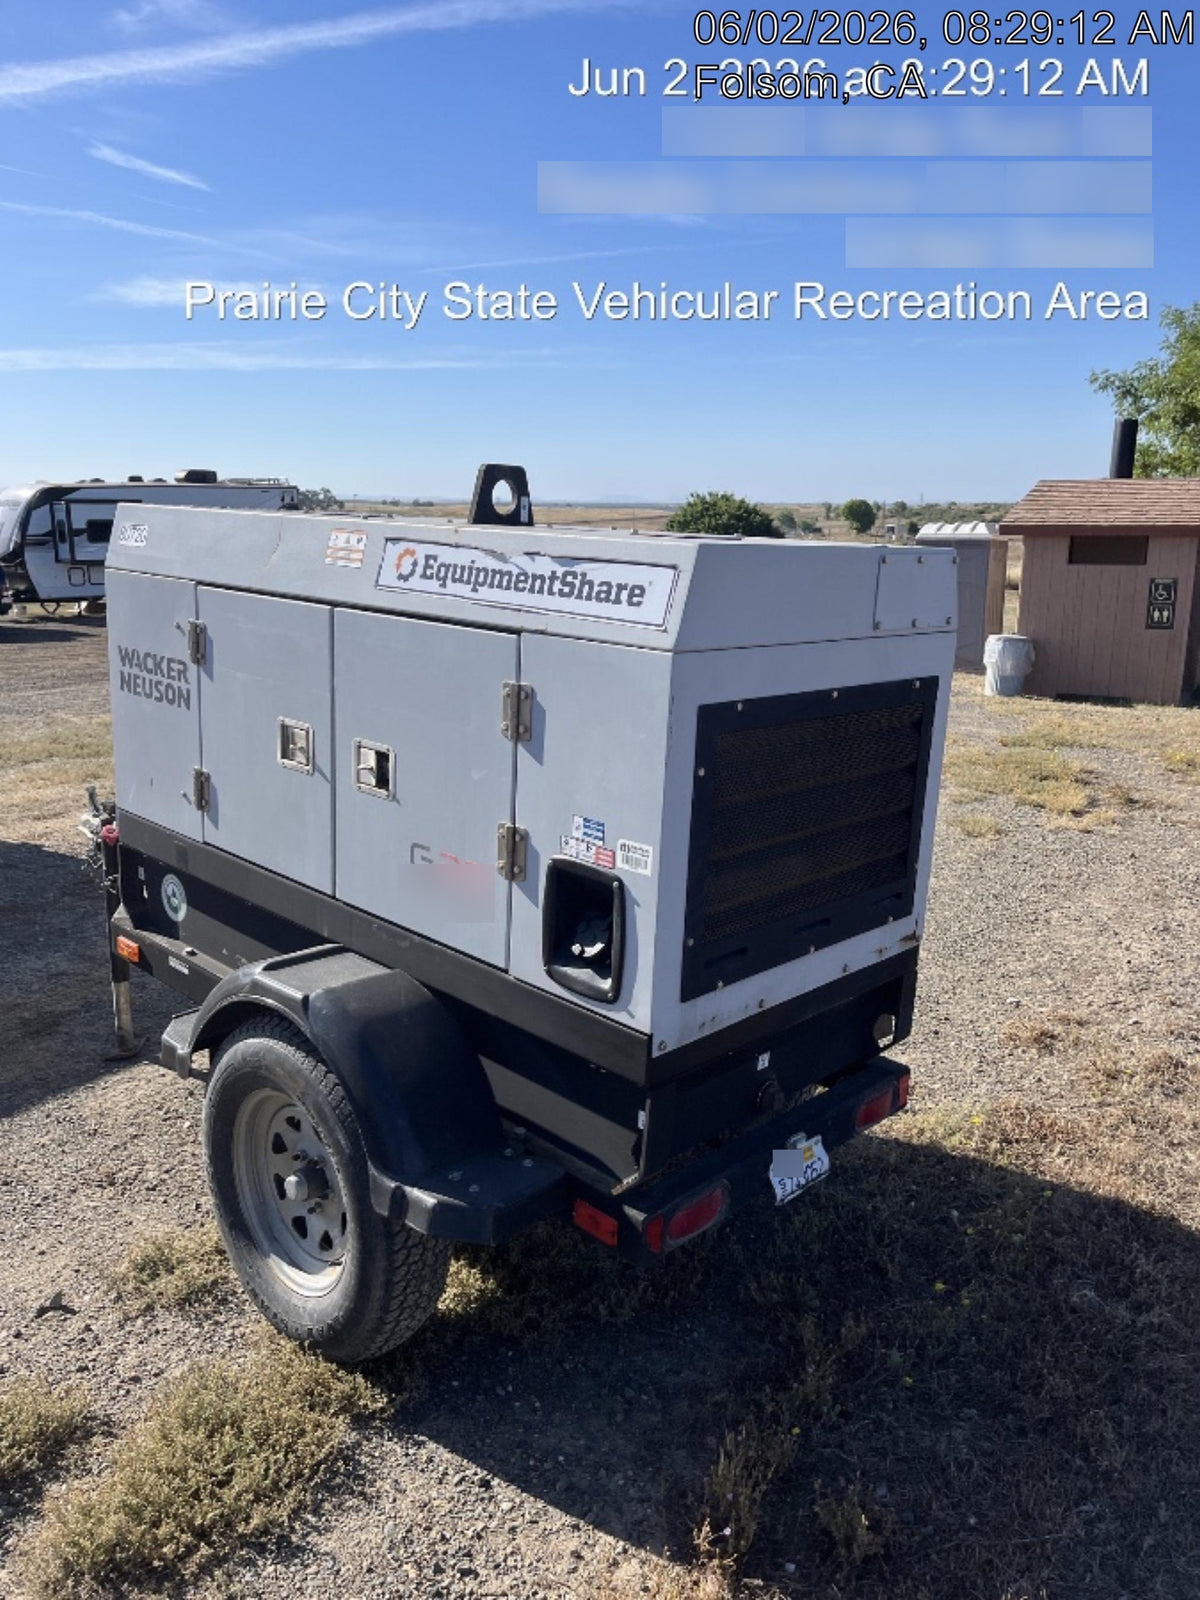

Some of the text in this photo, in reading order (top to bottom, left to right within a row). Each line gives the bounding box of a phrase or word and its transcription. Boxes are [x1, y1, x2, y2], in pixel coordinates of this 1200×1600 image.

[419, 553, 647, 608] EquipmentShare
[117, 645, 191, 685] WACKER
[120, 670, 190, 711] NEUSON
